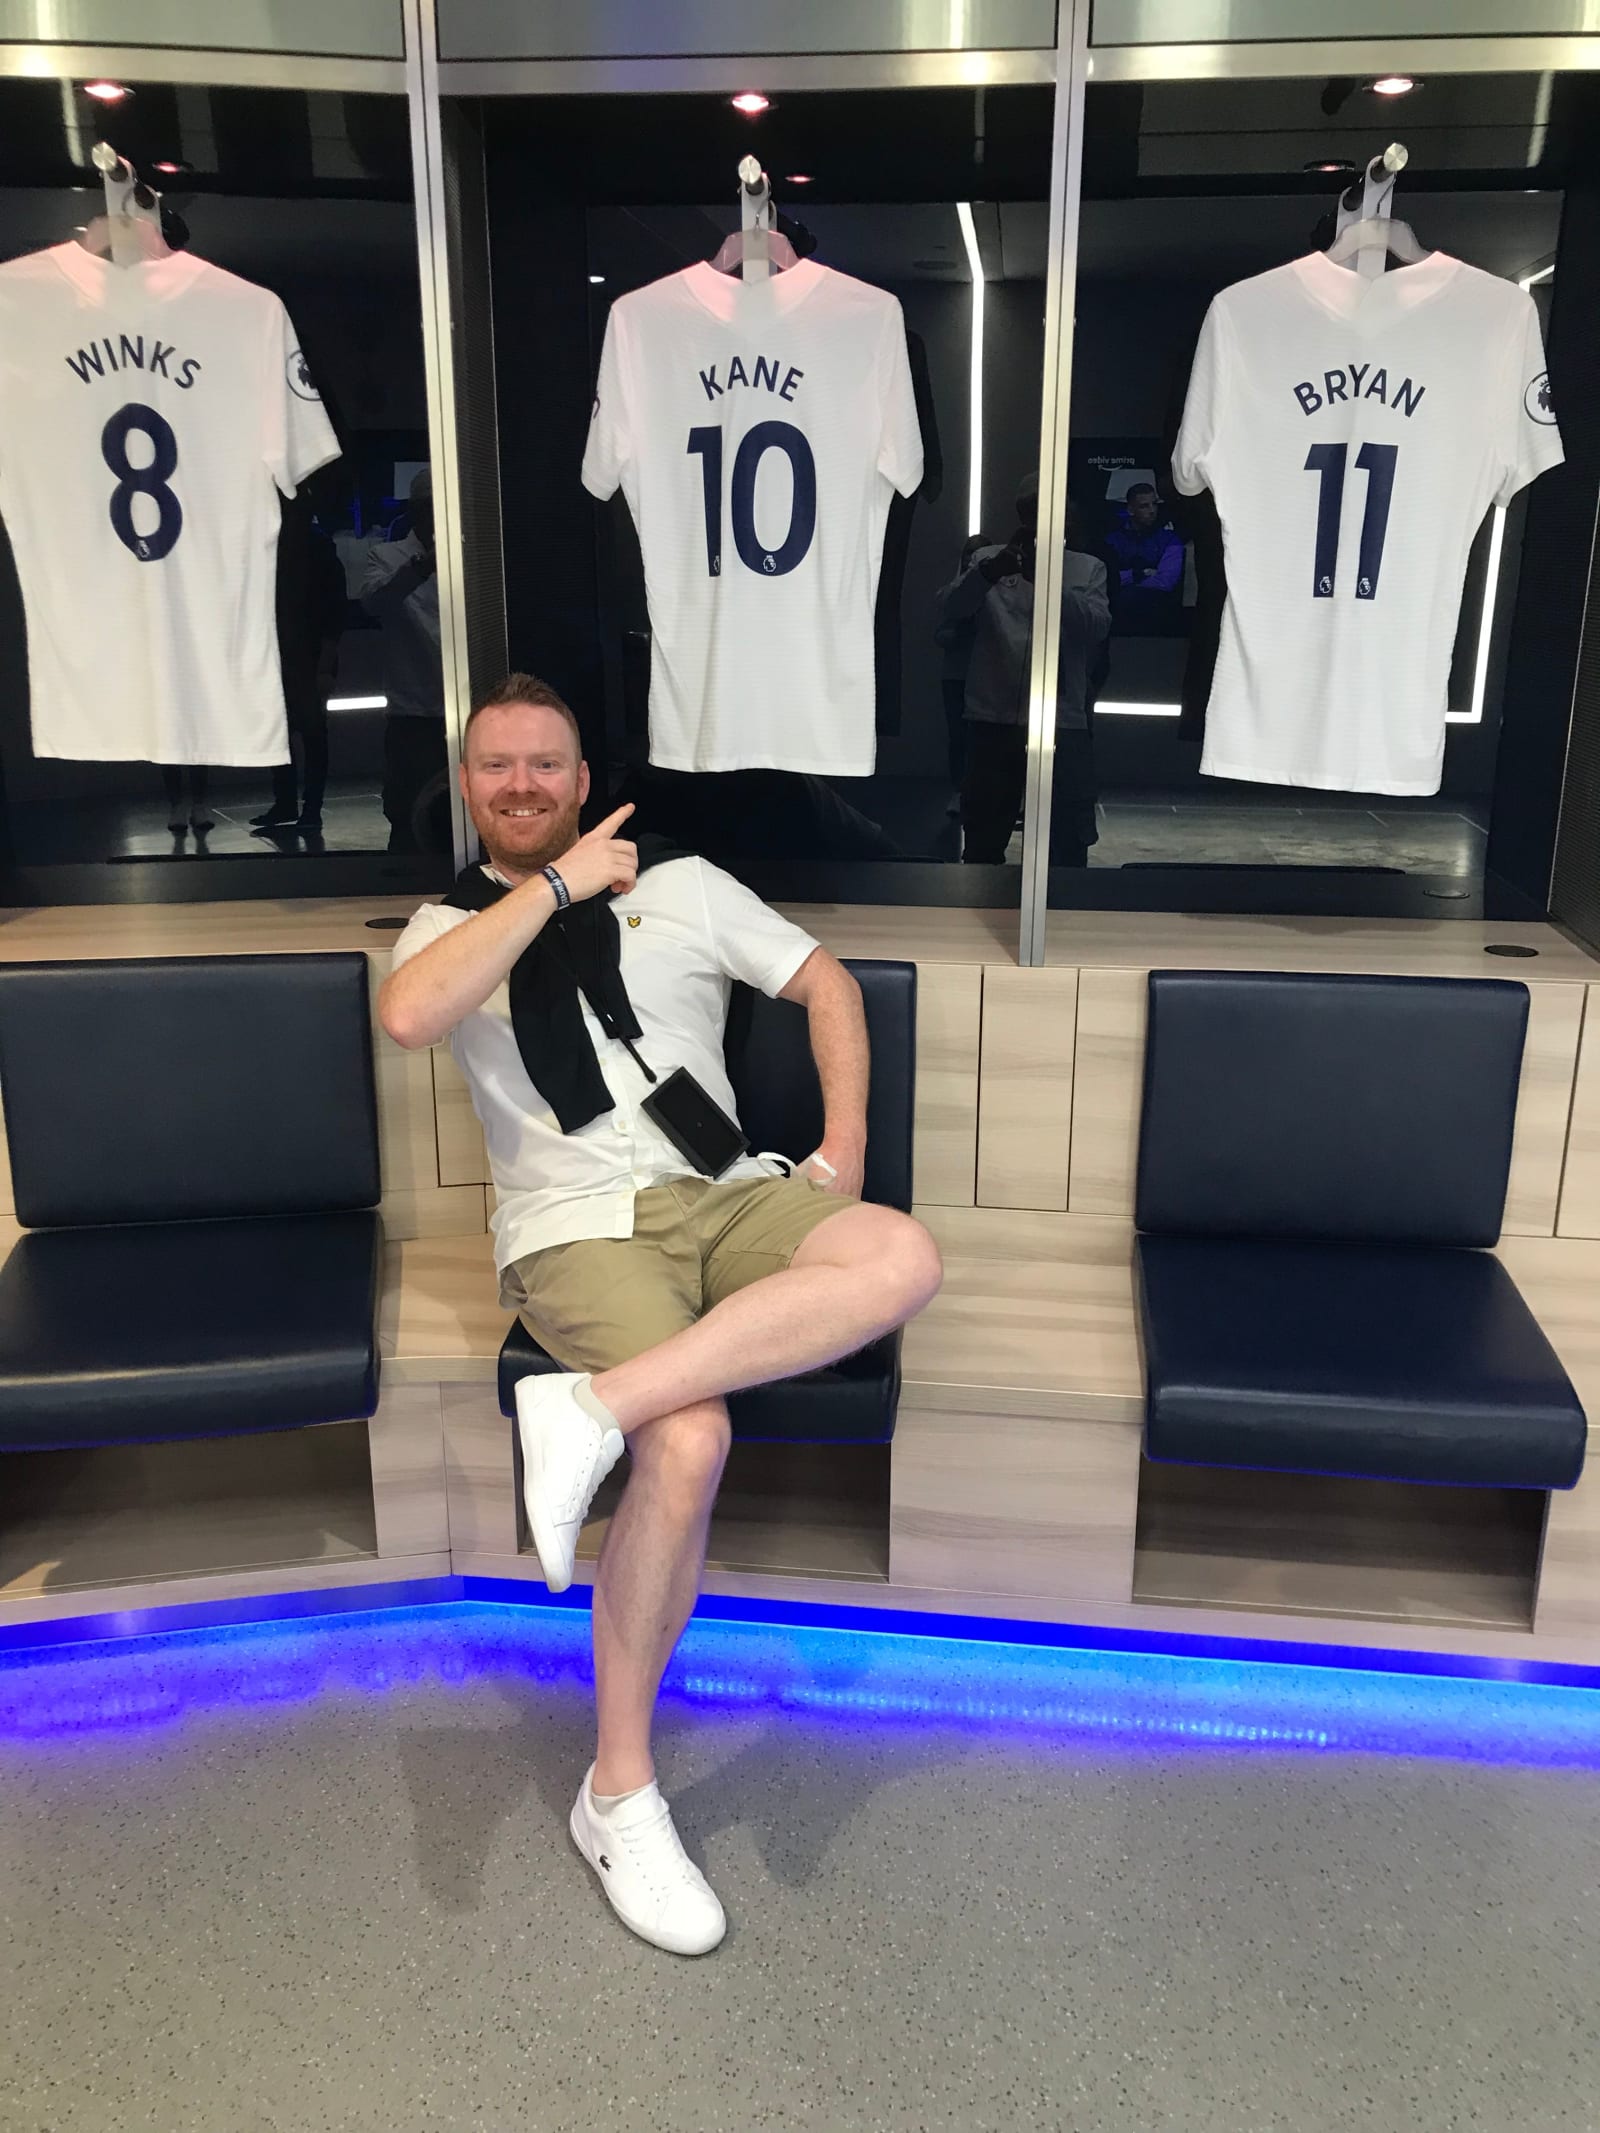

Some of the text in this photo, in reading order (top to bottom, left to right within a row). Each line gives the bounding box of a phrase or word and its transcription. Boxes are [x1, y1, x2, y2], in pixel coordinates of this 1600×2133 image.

[65, 334, 202, 389] WINKS
[699, 355, 805, 403] KANE
[1293, 363, 1426, 418] BRYAN
[100, 402, 183, 563] 8
[686, 420, 818, 578] 10
[1303, 441, 1399, 601] 11
